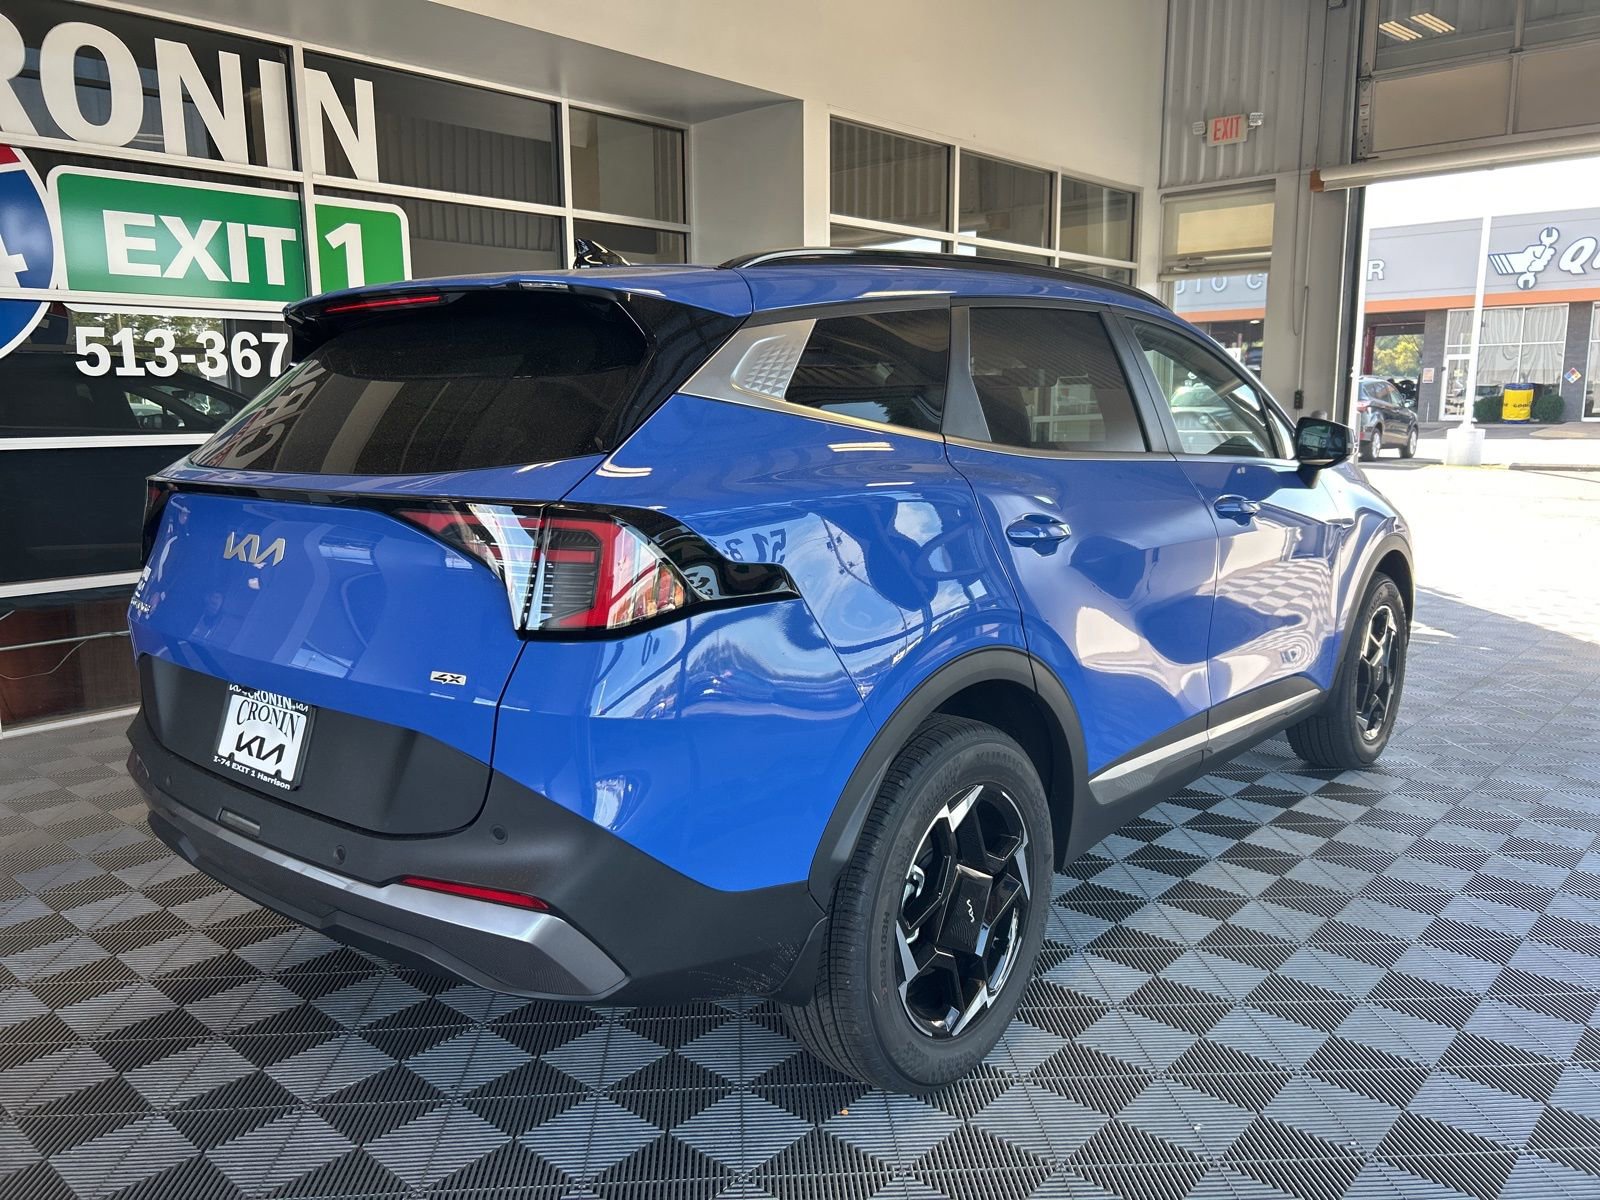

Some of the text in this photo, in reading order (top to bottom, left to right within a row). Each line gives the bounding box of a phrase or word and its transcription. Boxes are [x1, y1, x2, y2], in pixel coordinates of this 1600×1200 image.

[1213, 116, 1241, 142] EXIT
[103, 210, 365, 289] EXIT 1
[223, 531, 285, 567] KIA
[236, 699, 301, 742] CRONIN
[235, 731, 286, 766] KIA
[213, 755, 291, 791] I-74 EXIT 1 Harrison
